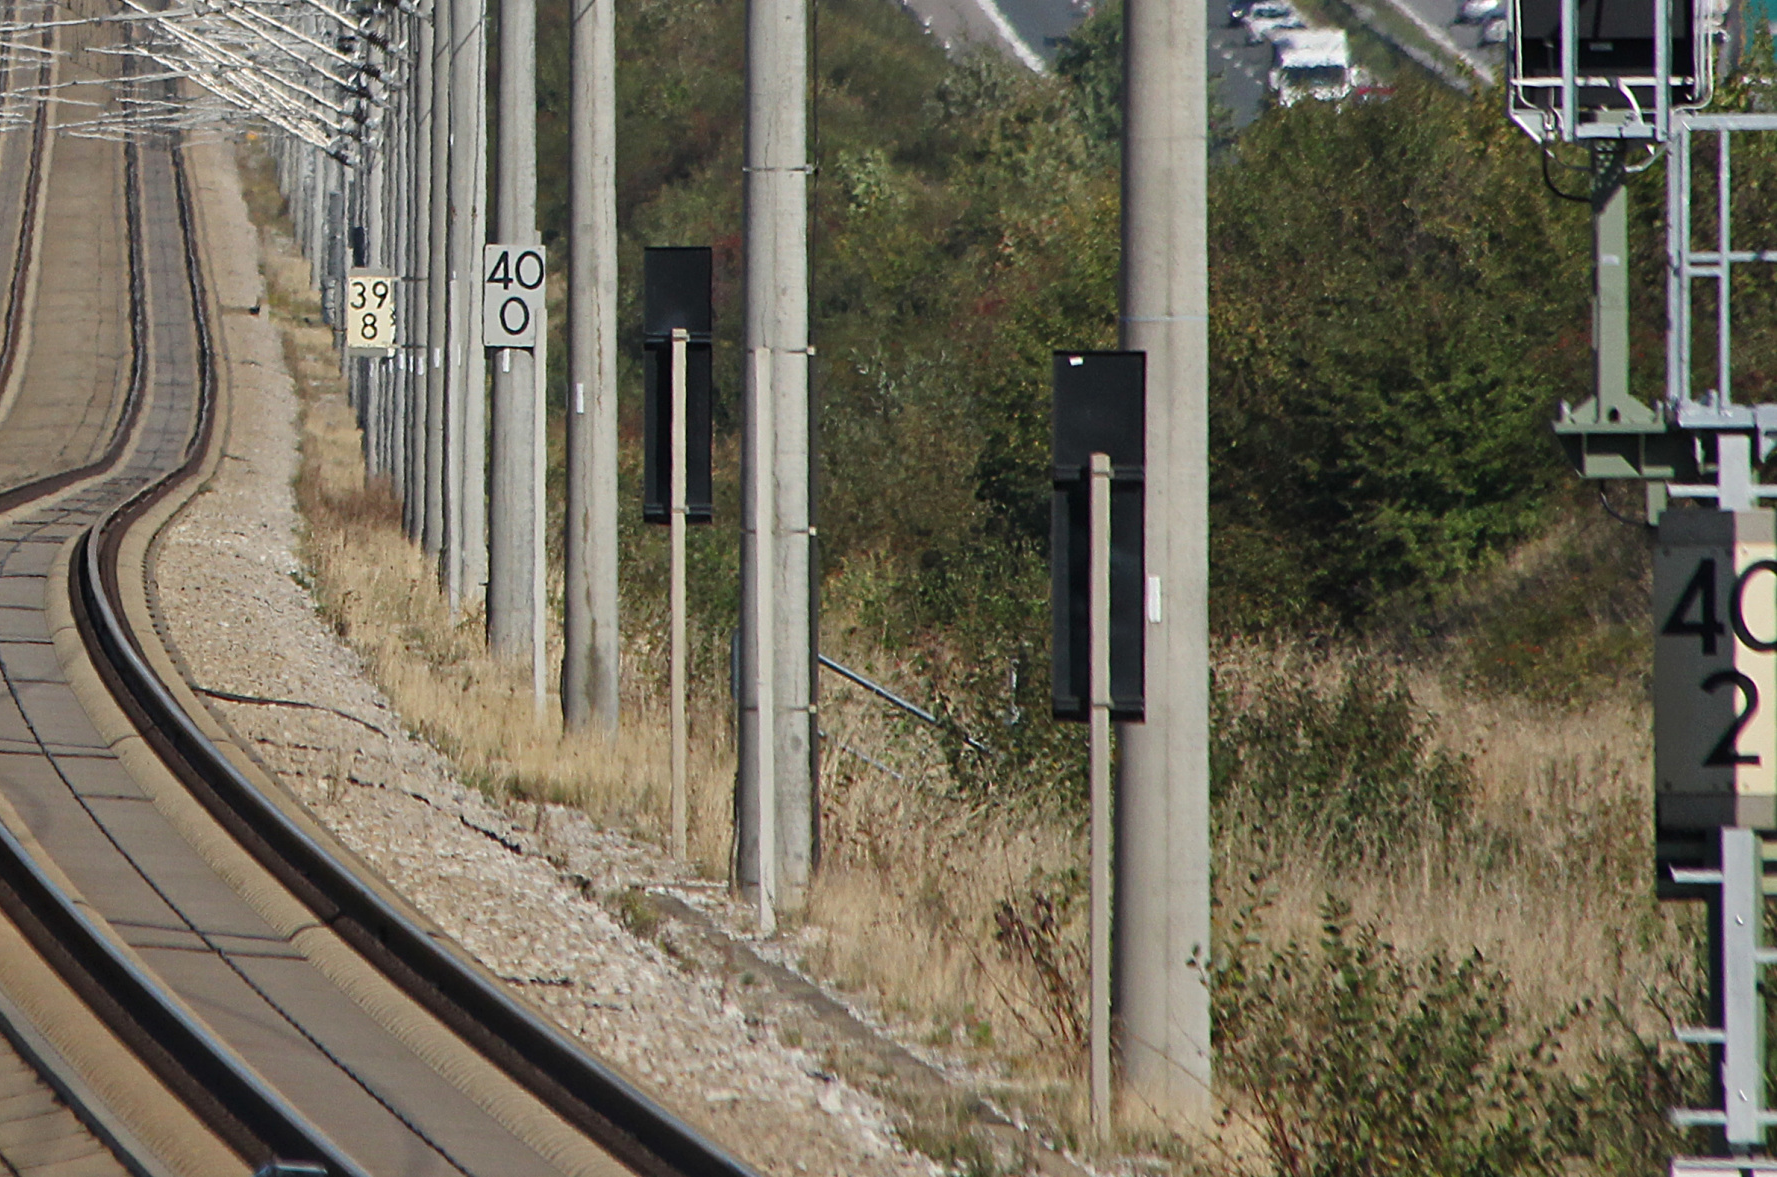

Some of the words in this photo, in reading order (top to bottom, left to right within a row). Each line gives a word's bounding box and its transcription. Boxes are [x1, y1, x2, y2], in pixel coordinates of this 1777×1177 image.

[487, 250, 545, 290] 40
[350, 281, 389, 310] 39
[360, 312, 378, 340] 8
[499, 296, 530, 335] 0
[1661, 557, 1777, 657] 40
[1700, 669, 1762, 769] 2
